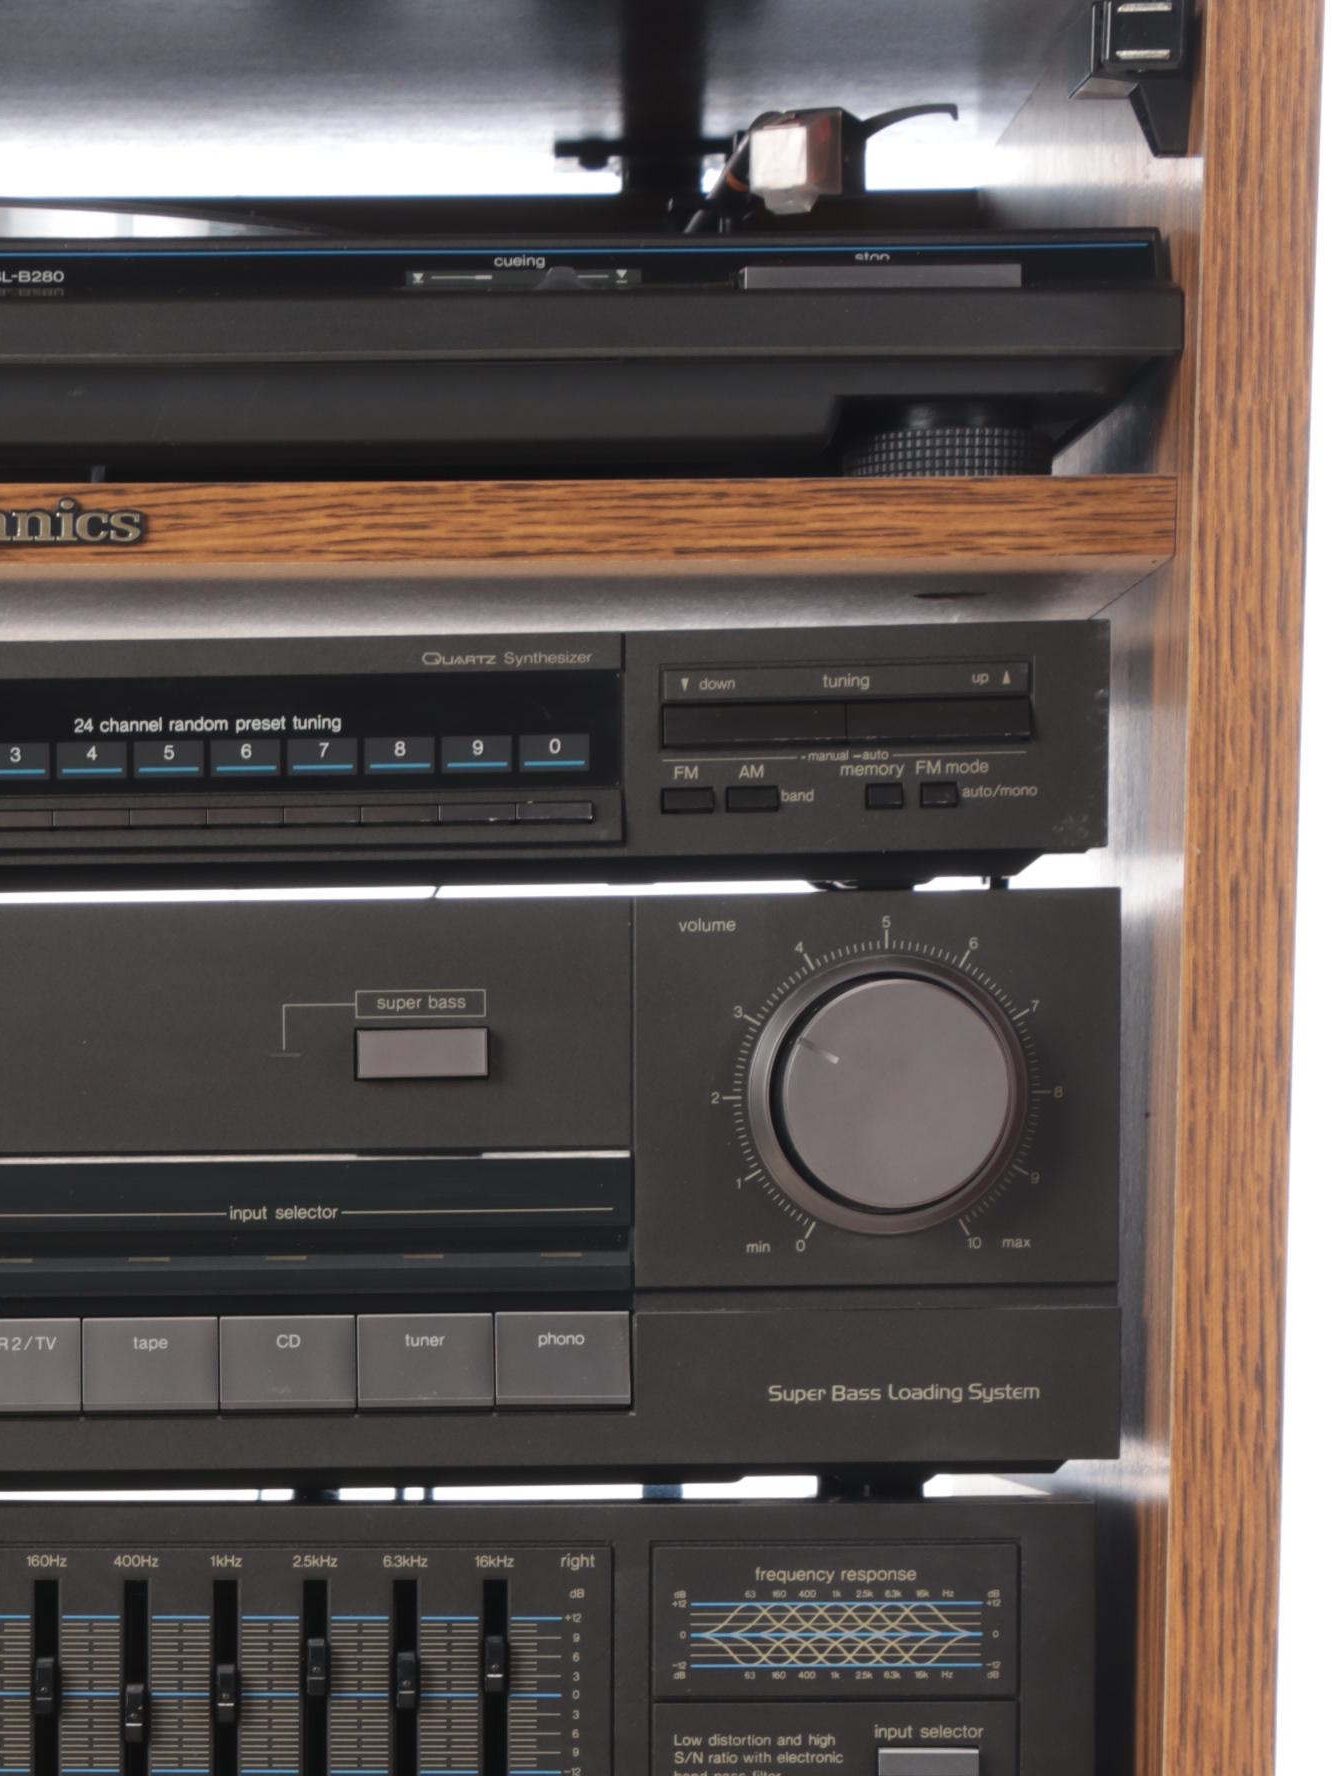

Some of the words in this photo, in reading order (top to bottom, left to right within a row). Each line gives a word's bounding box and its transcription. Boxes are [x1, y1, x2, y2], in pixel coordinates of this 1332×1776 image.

[494, 255, 546, 269] cueing
[503, 651, 593, 668] Synthesizer
[699, 677, 736, 691] down
[822, 672, 870, 691] tuning
[971, 673, 989, 685] up
[74, 717, 94, 734] 24
[99, 716, 163, 733] channel
[168, 716, 229, 732] random
[235, 715, 287, 734] preset
[292, 714, 342, 733] tuning
[674, 765, 699, 780] FM
[738, 764, 765, 778] AM
[840, 763, 905, 779] memory
[915, 759, 942, 775] FM
[945, 759, 989, 774] mode
[780, 789, 815, 802] band
[961, 784, 1038, 798] auto/mono
[678, 917, 737, 933] volume
[376, 997, 423, 1013] super
[427, 994, 467, 1010] bass
[229, 1205, 268, 1223] input
[275, 1204, 339, 1220] selector
[133, 1336, 169, 1352] tape
[275, 1333, 301, 1349] CD
[404, 1333, 446, 1348] tuner
[537, 1331, 586, 1348] phono
[768, 1384, 827, 1405] Super
[831, 1384, 882, 1402] Bass
[887, 1383, 963, 1404] Loading
[967, 1382, 1040, 1404] System
[560, 1552, 596, 1571] right
[755, 1566, 836, 1585] frequency
[840, 1569, 917, 1584] response
[673, 1734, 703, 1747] Low
[707, 1733, 772, 1747] distortion
[776, 1734, 802, 1746] and
[808, 1733, 836, 1749] high
[674, 1750, 704, 1765] S/N
[708, 1751, 739, 1765] ratio
[742, 1751, 772, 1764] with
[776, 1751, 844, 1764] electronic
